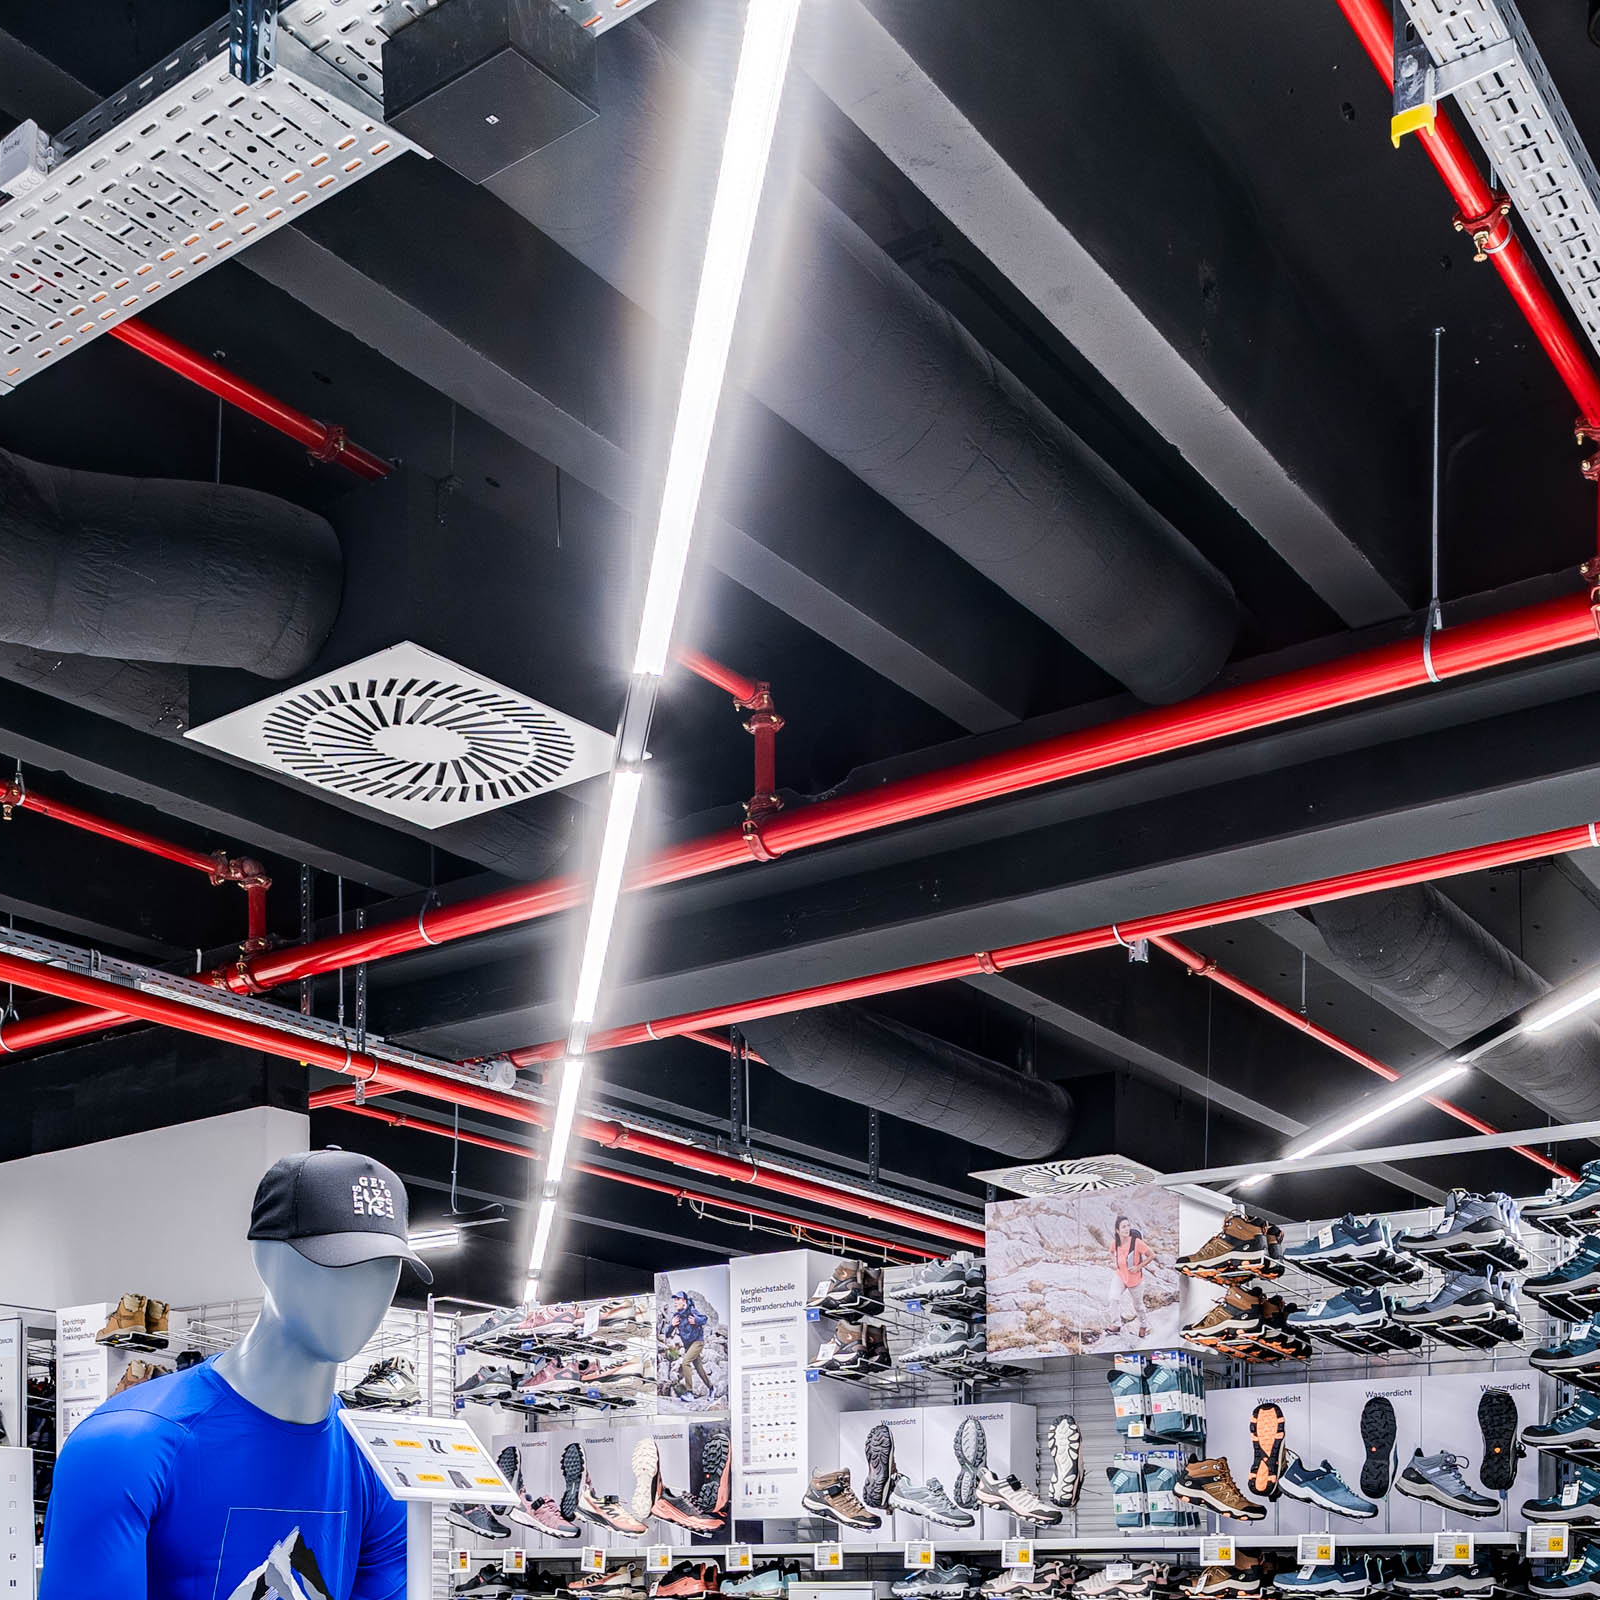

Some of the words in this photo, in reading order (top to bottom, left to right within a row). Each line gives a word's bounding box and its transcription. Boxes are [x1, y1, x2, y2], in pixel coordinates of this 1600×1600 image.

[359, 1176, 386, 1189] GET
[740, 1283, 795, 1296] Vergleichstabelle
[740, 1296, 762, 1304] leichte
[740, 1300, 803, 1313] Bergwanderschuhe
[1365, 1389, 1412, 1398] Wasserdicht
[1259, 1395, 1302, 1407] Wasserdicht
[881, 1418, 916, 1426] Wasserdicht
[966, 1413, 1004, 1422] Wasserdicht
[653, 1433, 683, 1441] Wasserdicht
